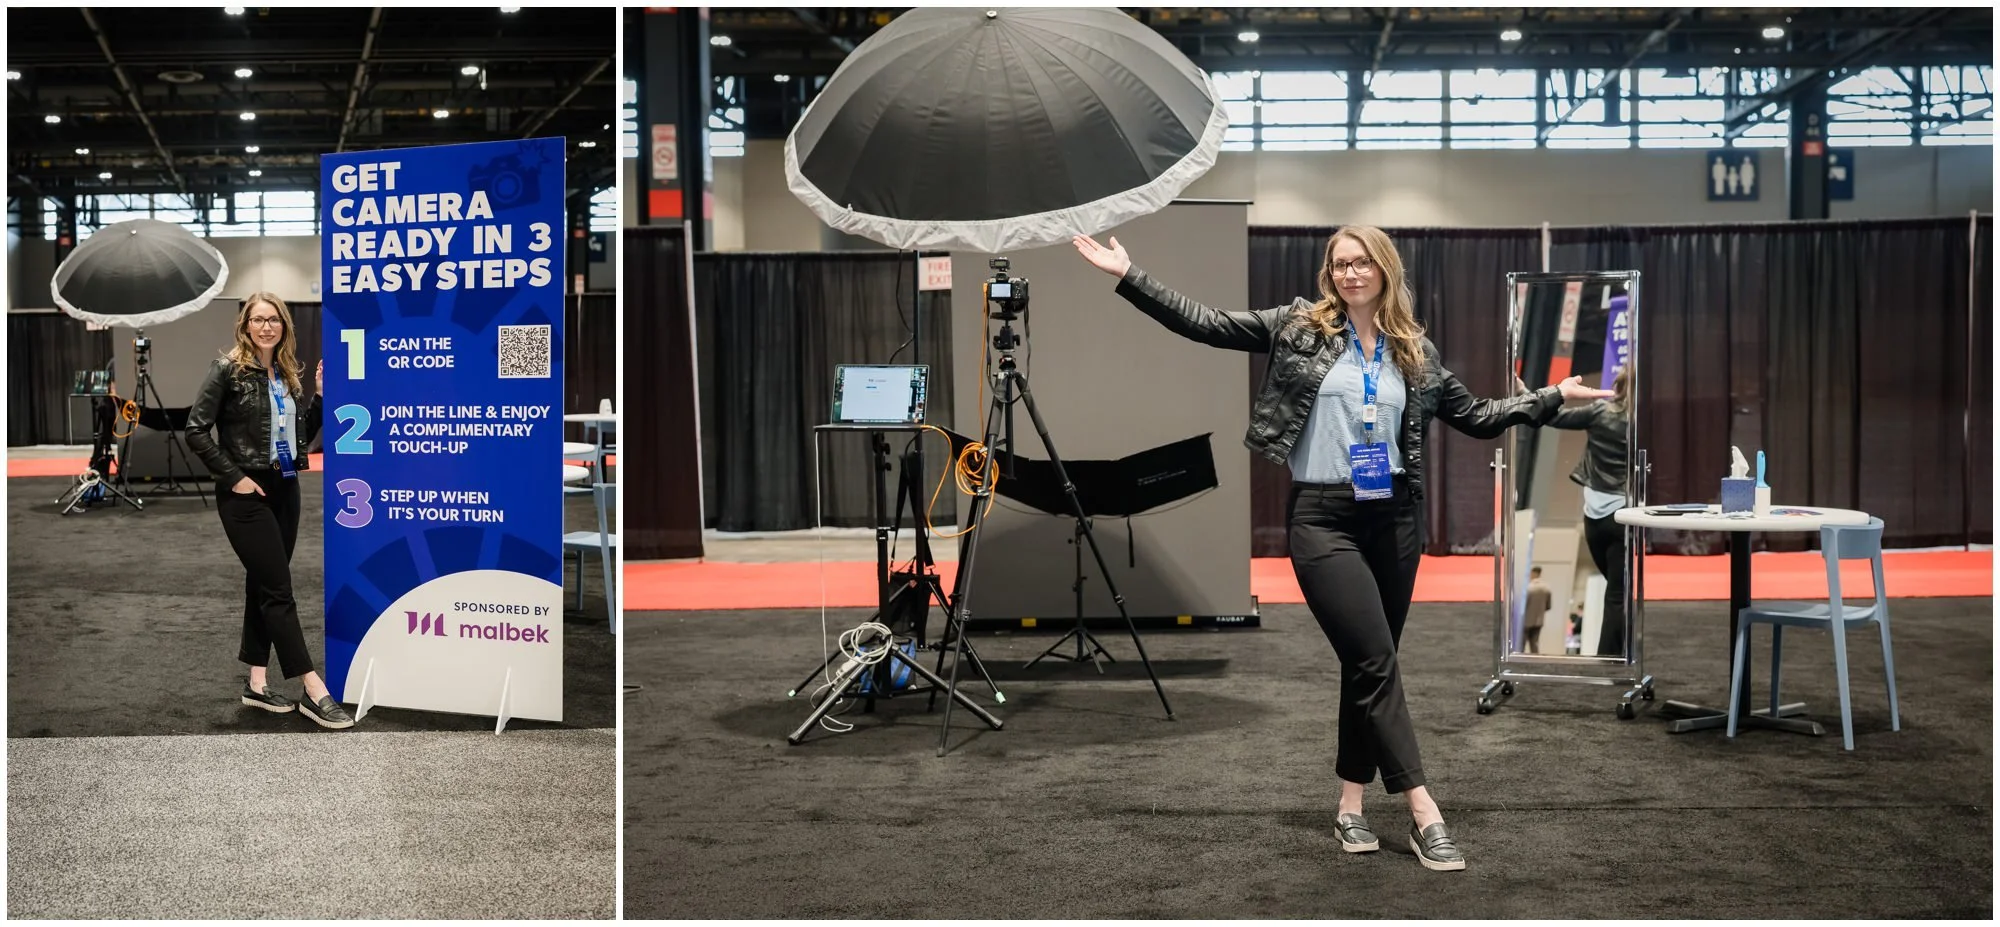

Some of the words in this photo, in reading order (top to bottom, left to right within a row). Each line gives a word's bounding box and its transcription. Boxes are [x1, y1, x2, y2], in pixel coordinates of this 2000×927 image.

[332, 162, 401, 193] GET
[332, 191, 494, 227] CAMERA
[332, 226, 458, 260] READY
[473, 224, 512, 255] IN
[528, 222, 552, 252] 3
[332, 262, 430, 294] EASY
[435, 258, 552, 290] STEPS
[379, 338, 420, 351] SCAN
[423, 337, 452, 350] THE
[340, 328, 366, 380] 1
[387, 356, 410, 369] QR
[412, 355, 455, 369] CODE
[380, 405, 414, 422] JOIN
[416, 405, 446, 419] THE
[448, 405, 482, 419] LINE
[485, 405, 498, 419] &
[501, 405, 551, 422] ENJOY
[333, 403, 374, 455] 2
[389, 423, 401, 436] A
[403, 423, 534, 437] COMPLIMENTARY
[388, 440, 469, 454] TOUCH-UP
[334, 478, 374, 529] 3
[380, 489, 415, 503] STEP
[418, 490, 438, 503] UP
[440, 491, 489, 505] WHEN
[388, 506, 415, 520] IT'S
[416, 507, 460, 522] YOUR
[461, 508, 504, 523] TURN
[454, 601, 530, 616] SPONSORED
[534, 606, 550, 616] BY
[459, 622, 550, 644] malbek
